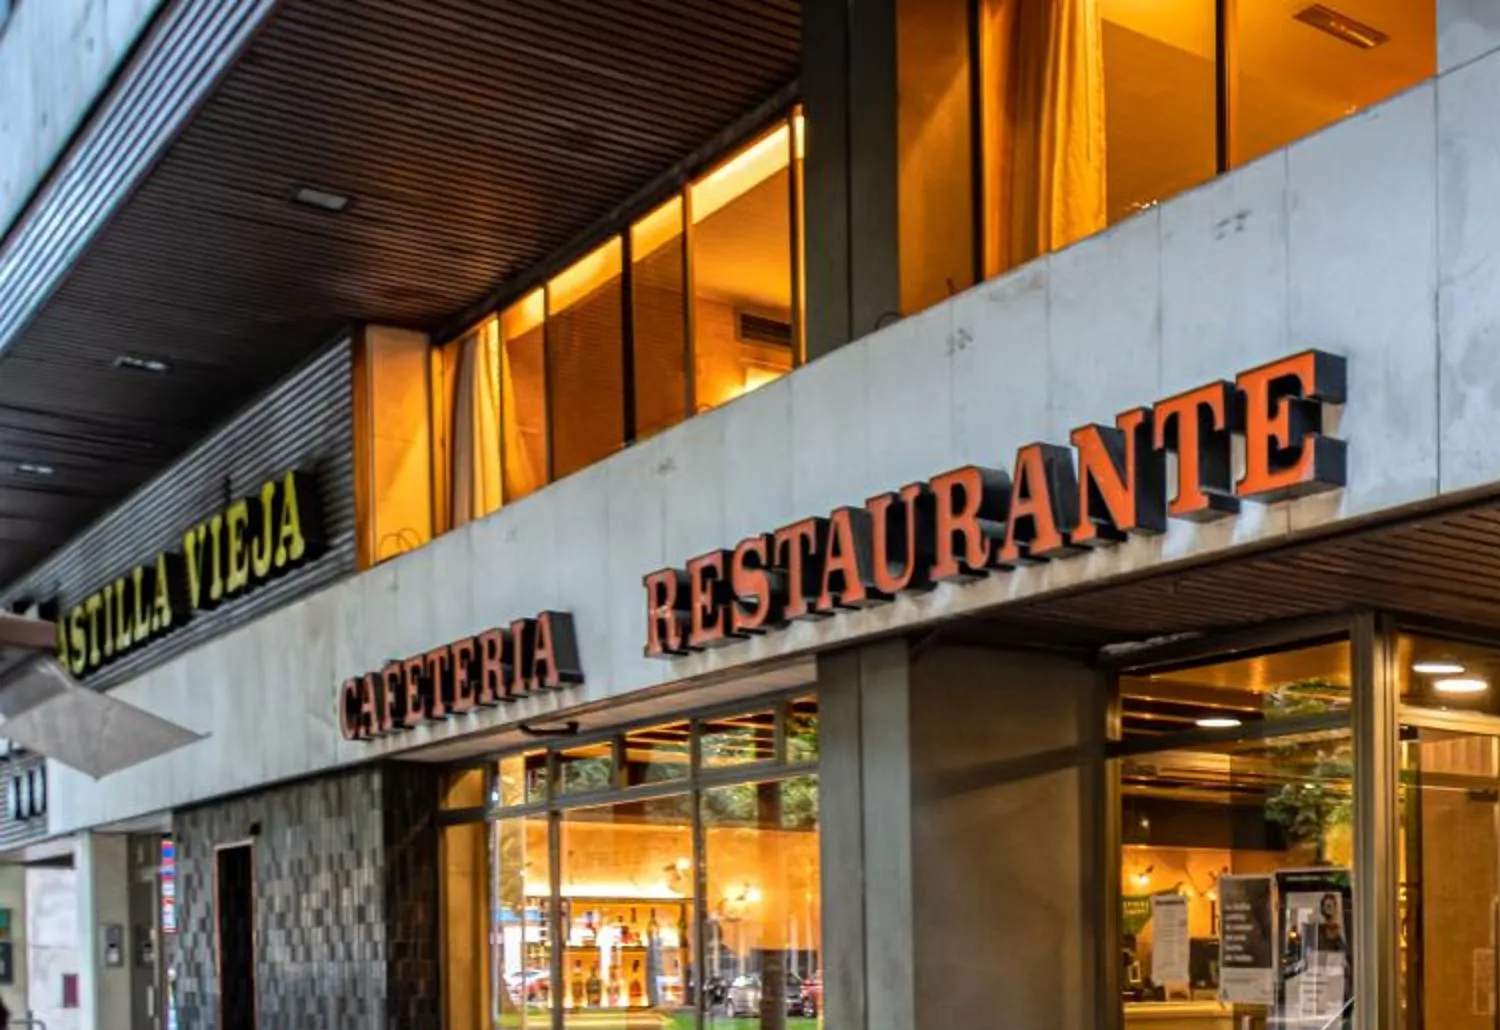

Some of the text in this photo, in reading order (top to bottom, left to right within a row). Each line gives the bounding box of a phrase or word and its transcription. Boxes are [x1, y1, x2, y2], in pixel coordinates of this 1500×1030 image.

[57, 469, 305, 675] ASTILLA VIEJA
[643, 348, 1318, 658] RESTAURANTE
[339, 611, 562, 741] CAFETERIA
